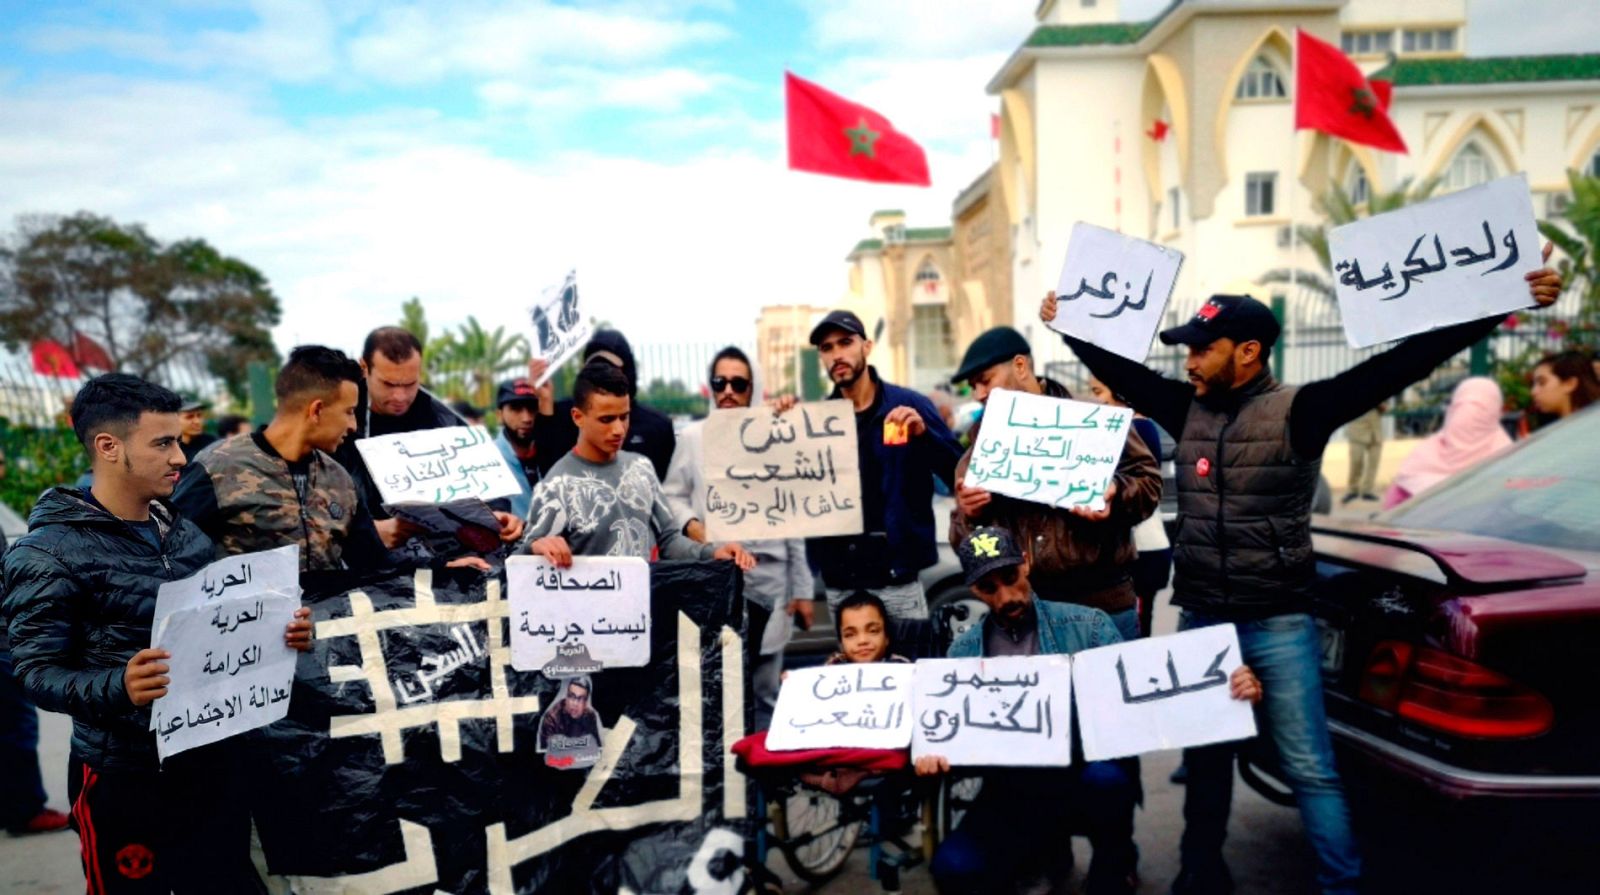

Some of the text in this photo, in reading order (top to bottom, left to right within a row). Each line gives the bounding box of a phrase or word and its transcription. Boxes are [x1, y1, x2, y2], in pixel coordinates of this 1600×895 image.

[1450, 220, 1519, 276] ولد
[740, 408, 845, 453] عاش
[725, 445, 836, 489] الشعب
[803, 491, 855, 518] عاش
[536, 565, 621, 592] الصحافة
[211, 601, 263, 634] الحرية
[520, 611, 646, 642] ليست جريمة
[203, 645, 261, 676] الكرامة
[1115, 644, 1231, 704] كلنا
[249, 680, 291, 708] لعدالة
[812, 668, 897, 701] عاش
[925, 669, 1039, 697] سيمو
[789, 702, 904, 734] الشعب
